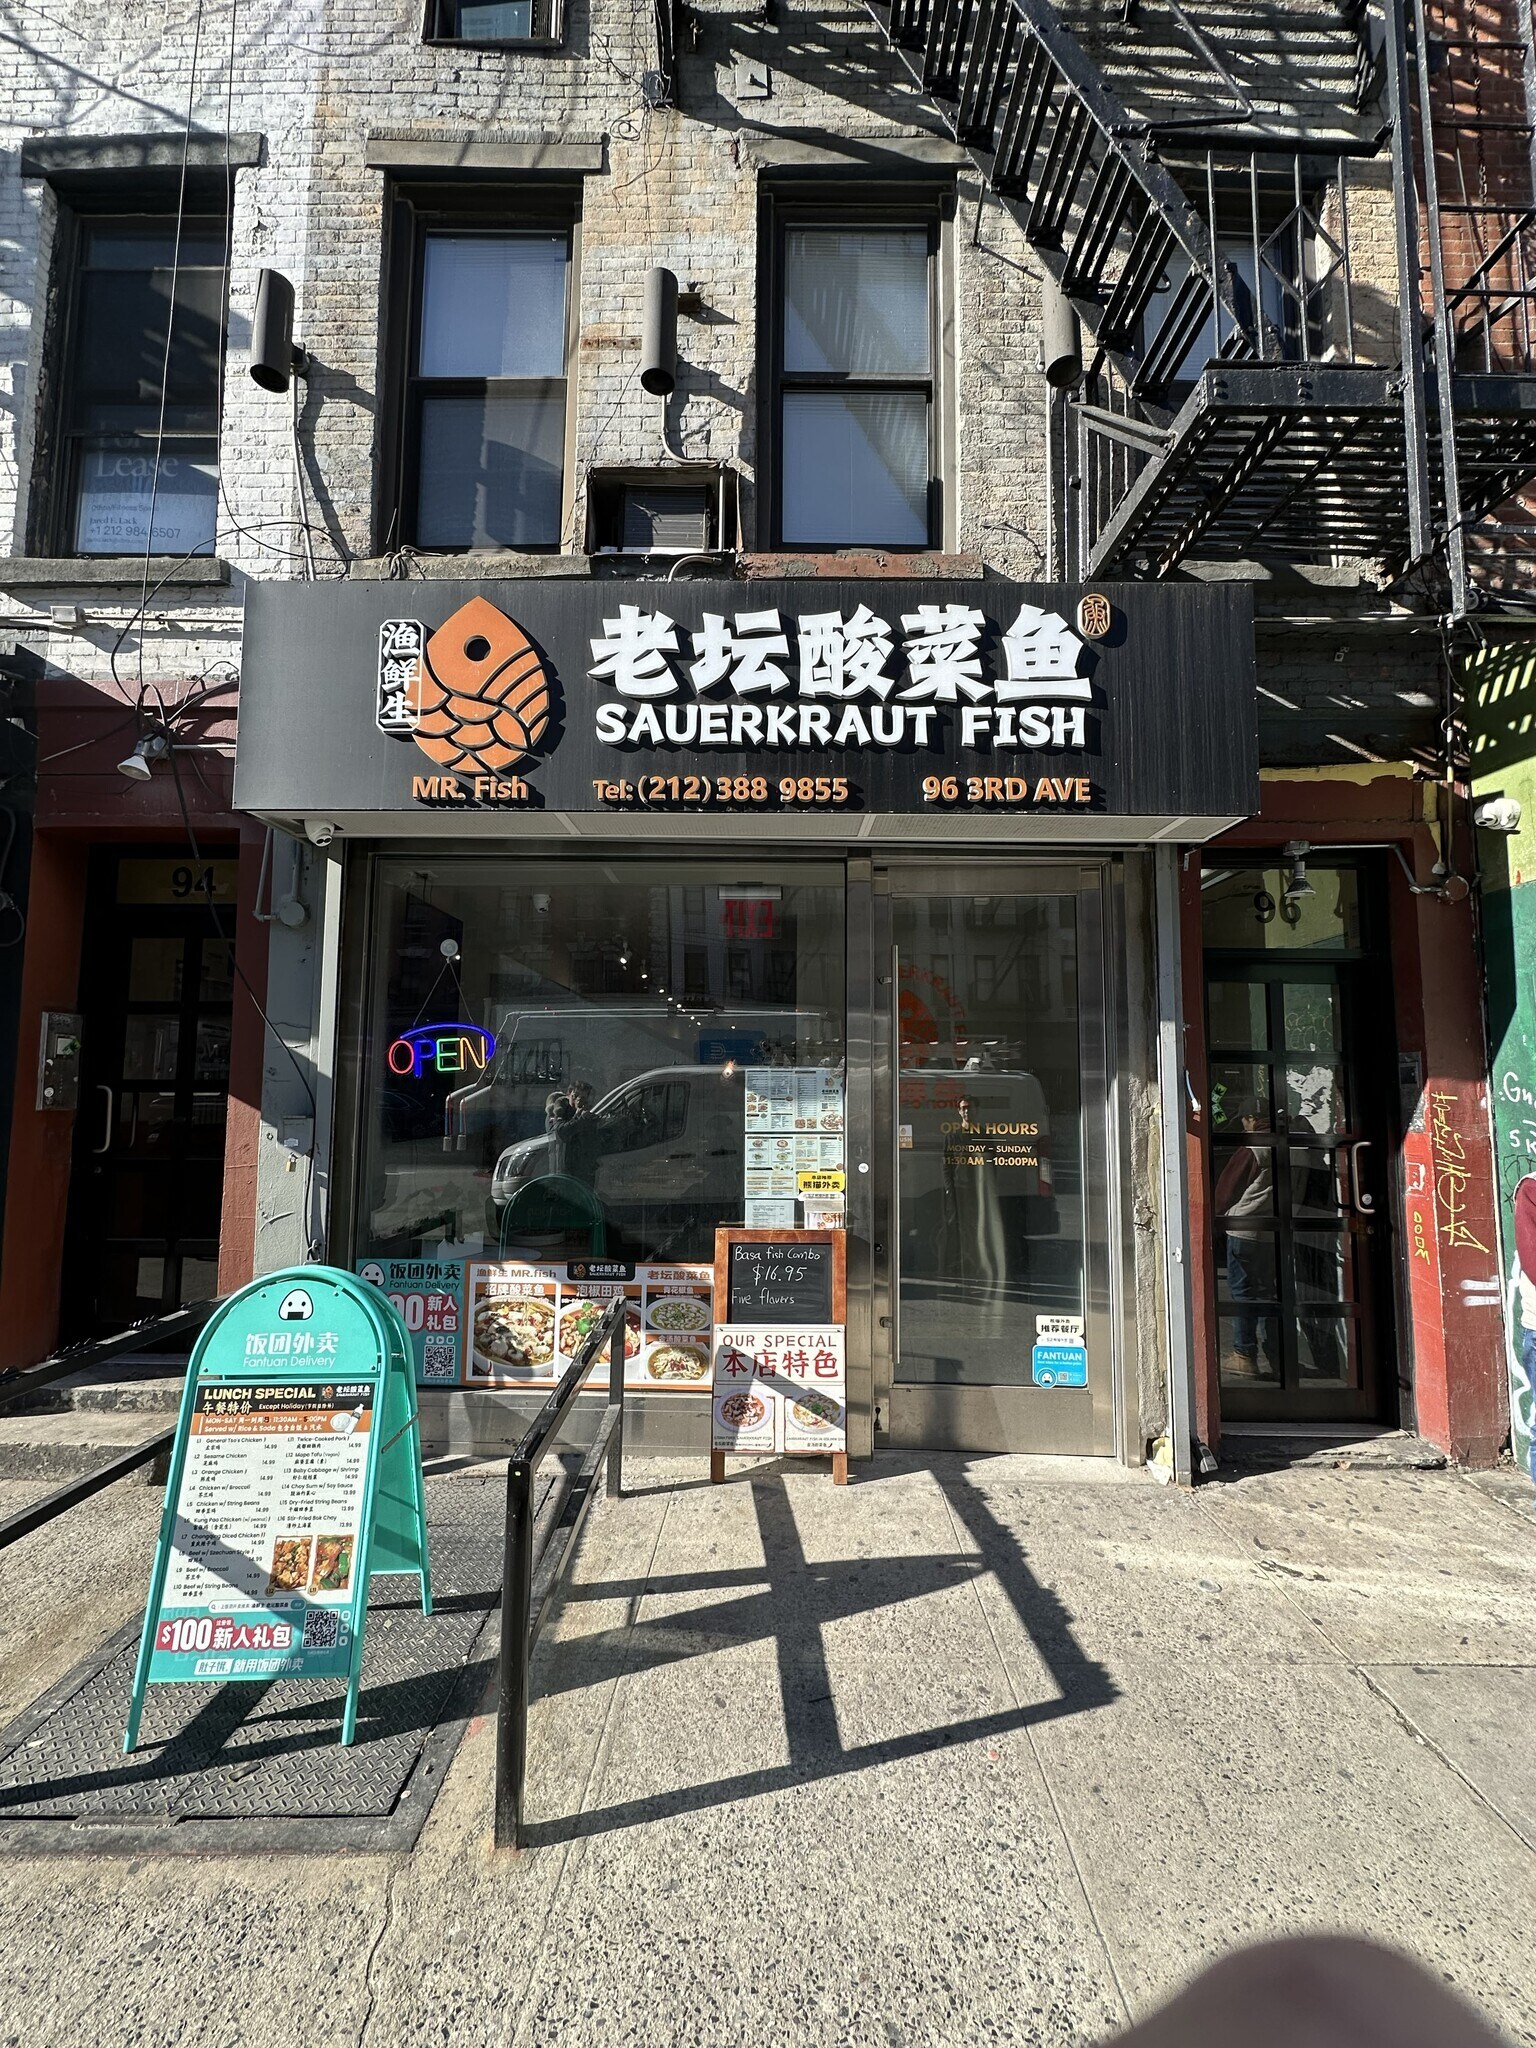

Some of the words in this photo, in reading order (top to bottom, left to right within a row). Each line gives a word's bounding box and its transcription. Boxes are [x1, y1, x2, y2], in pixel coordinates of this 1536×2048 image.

[95, 450, 179, 477] Lease
[90, 526, 100, 535] +1
[104, 526, 122, 536] 212
[125, 526, 147, 536] 984
[152, 528, 181, 539] 6507
[587, 603, 1092, 702] 老坛酸菜鱼
[595, 703, 937, 746] SAUERKRAUT
[961, 705, 1085, 747] FISH
[412, 776, 466, 800] MR.
[474, 775, 529, 800] Fish
[779, 777, 848, 803] 9855
[922, 776, 959, 801] 96
[966, 776, 1027, 801] 3RD
[1033, 777, 1091, 802] AVE
[172, 867, 216, 897] 94
[1254, 891, 1301, 923] 96
[387, 1036, 486, 1078] OPEN
[940, 1122, 981, 1135] OPEN
[985, 1122, 1038, 1135] HOURS
[947, 1145, 986, 1153] MONDAY
[996, 1145, 1032, 1153] SUNDAY
[734, 1245, 761, 1261] Basa
[766, 1246, 784, 1259] fish
[787, 1247, 821, 1260] Combo
[389, 1262, 461, 1280] 饭团外卖
[647, 1270, 711, 1280] 老坛酸菜鱼
[752, 1263, 807, 1286] $16.95
[389, 1281, 423, 1289] Fantuan
[426, 1280, 459, 1291] Delivery
[485, 1284, 545, 1296] 招牌酸菜鱼
[576, 1284, 625, 1297] 泡椒田鸡
[427, 1295, 457, 1311] 新人
[732, 1287, 752, 1304] Five
[426, 1314, 457, 1331] 礼包
[245, 1332, 340, 1355] 饭团外卖
[722, 1334, 755, 1347] OUR
[764, 1334, 837, 1347] SPECIAL
[243, 1356, 288, 1368] Fantuan
[290, 1356, 335, 1368] Delivery
[721, 1349, 839, 1378] 本店特色
[1037, 1351, 1082, 1361] FANTUAN
[204, 1388, 253, 1400] LUNCH
[254, 1387, 316, 1400] SPECIAL
[203, 1401, 253, 1415] 午餐特价
[259, 1403, 280, 1411] Except
[228, 1424, 237, 1433] w/
[161, 1618, 213, 1651] $100
[212, 1626, 291, 1650] 新人礼包
